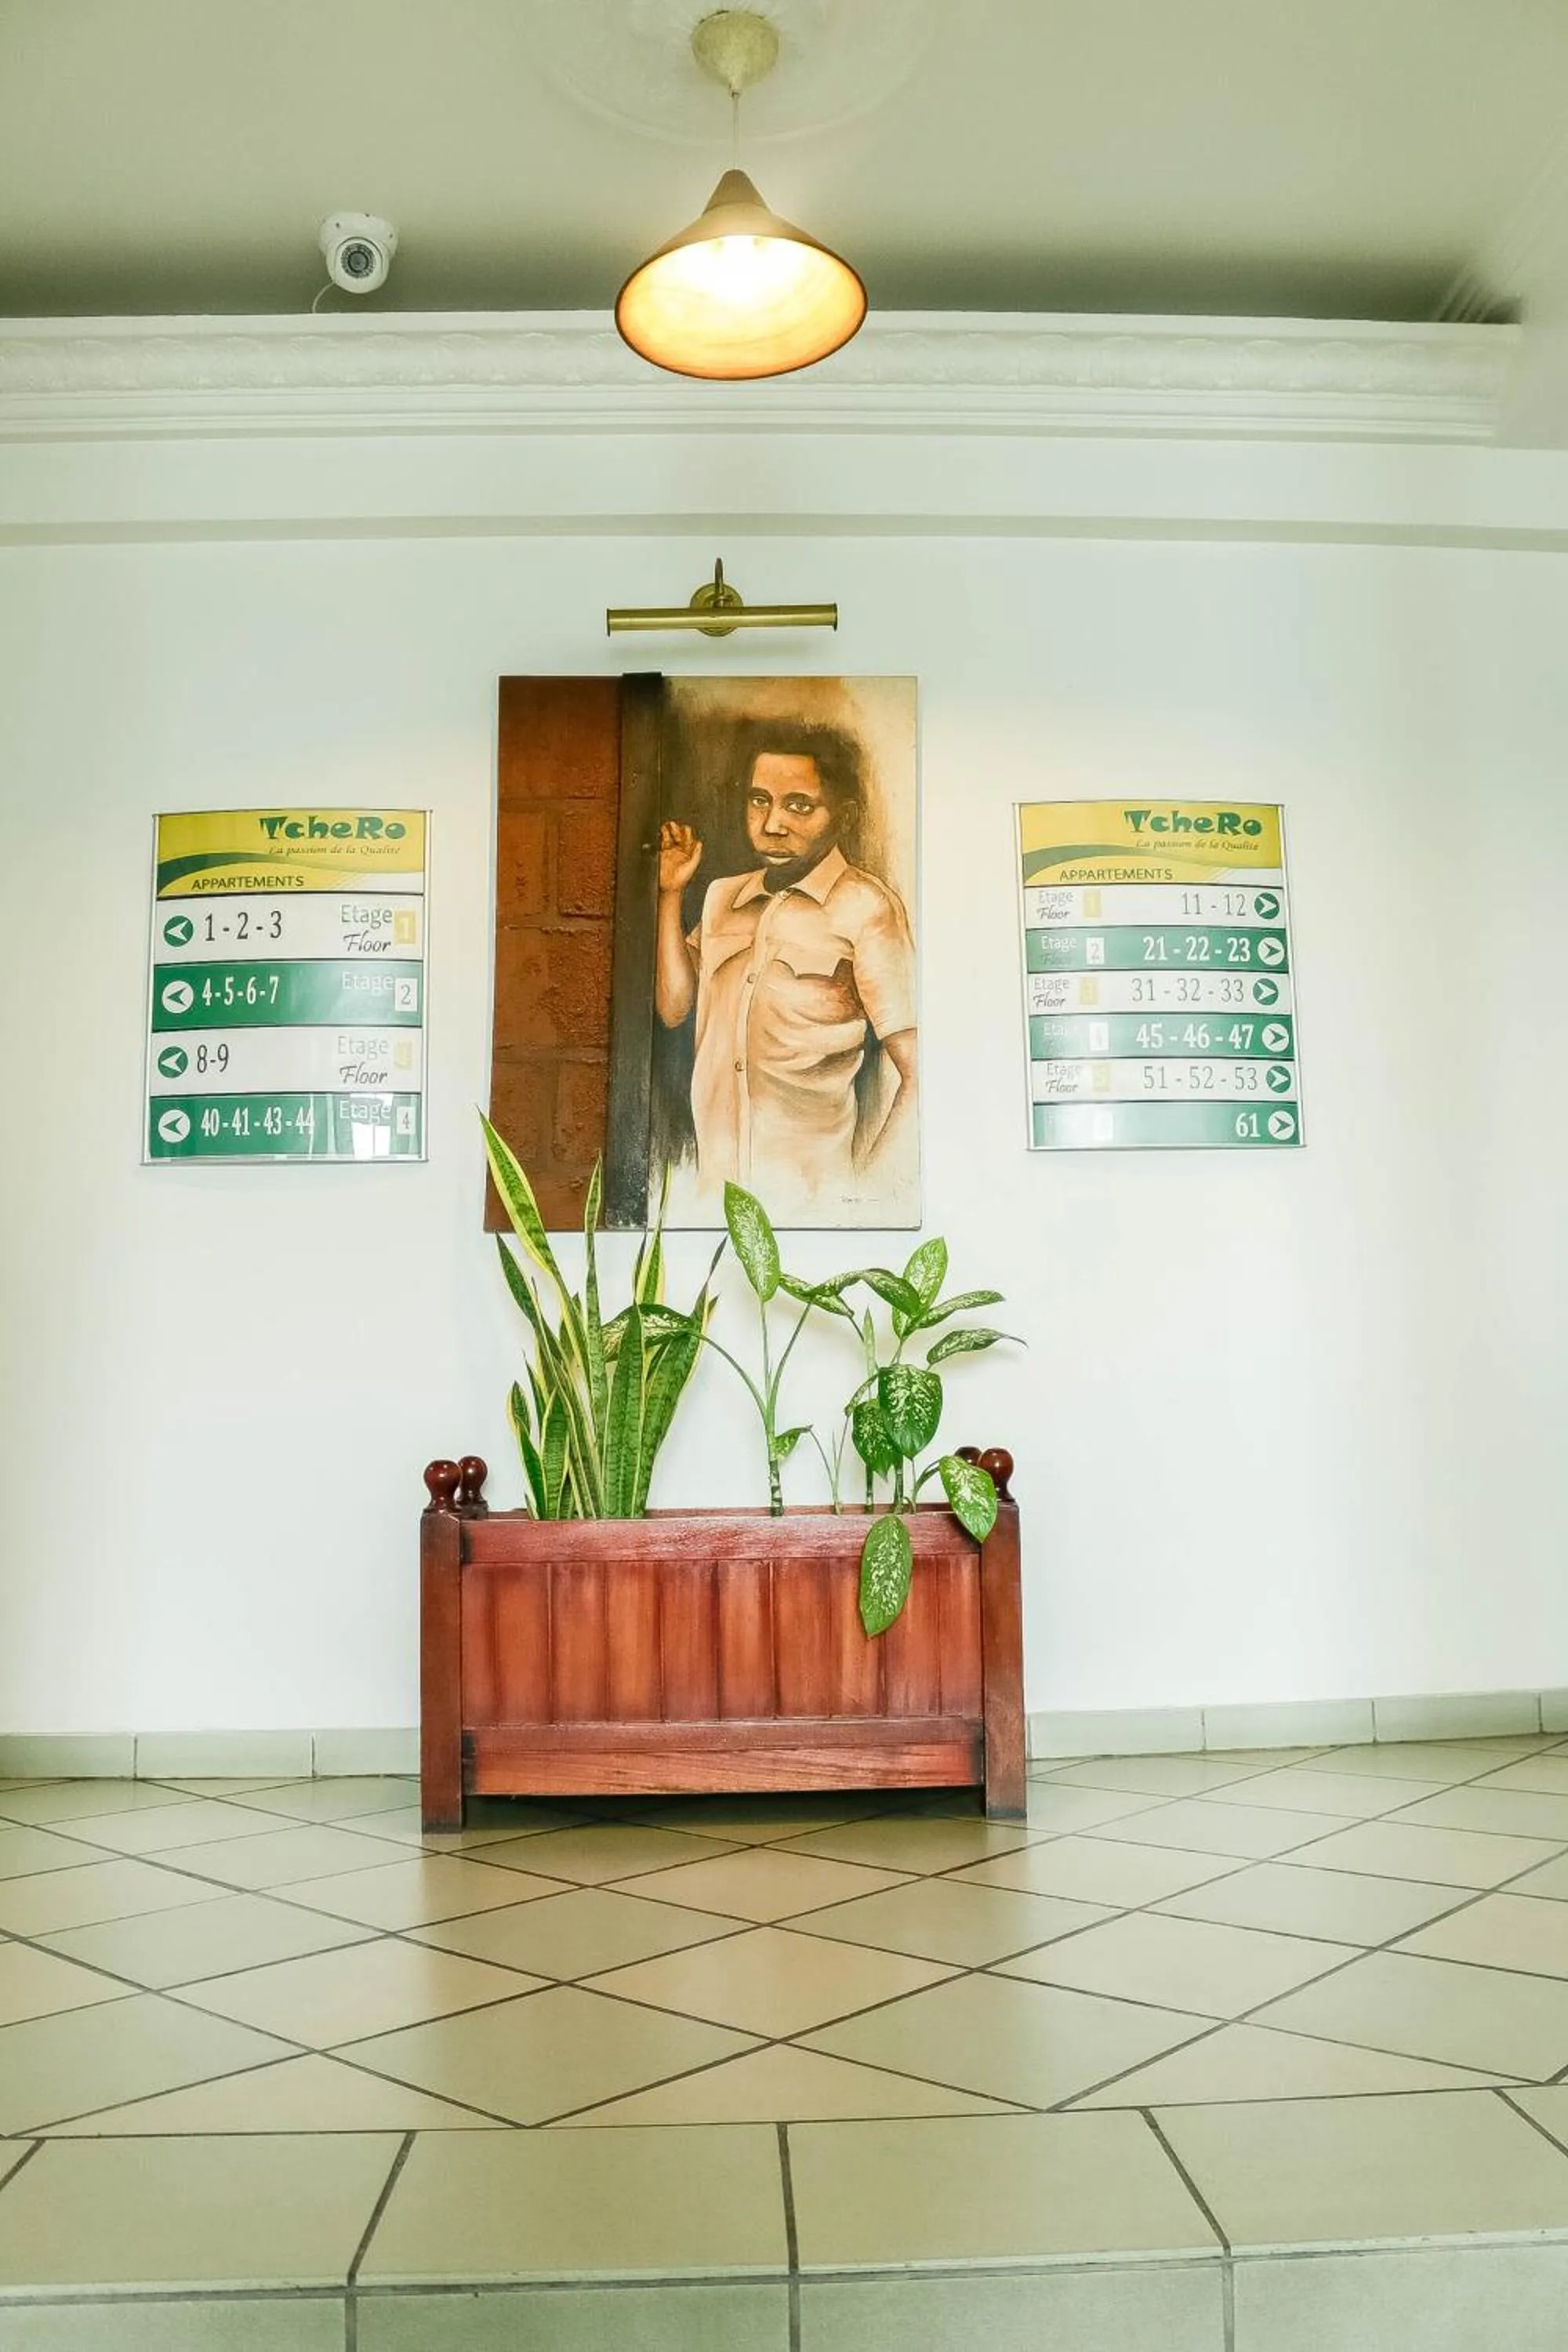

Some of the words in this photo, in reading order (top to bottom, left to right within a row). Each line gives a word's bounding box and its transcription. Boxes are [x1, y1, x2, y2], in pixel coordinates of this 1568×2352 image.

[259, 815, 406, 840] TcheRo
[1124, 810, 1262, 836] TcheRo
[286, 846, 326, 856] passion
[330, 845, 341, 854] de
[346, 845, 356, 854] la
[1153, 840, 1192, 849] passion
[1195, 839, 1206, 848] de
[1210, 839, 1220, 848] la
[191, 875, 304, 890] APPARTEMENTS
[1059, 867, 1173, 880] APPARTEMENTS
[1039, 890, 1074, 906] Etage
[340, 904, 393, 928] Etage
[343, 930, 391, 952] Floor
[1042, 935, 1077, 952] Etage
[1091, 942, 1100, 960] 2
[343, 972, 395, 996] Etage
[401, 984, 412, 1004] 2
[1034, 978, 1069, 993] Etage
[338, 1036, 389, 1060] Etage
[339, 1062, 387, 1084] Floor
[339, 1101, 390, 1123] Etage
[401, 1112, 411, 1131] 4
[1235, 1112, 1261, 1138] 61
